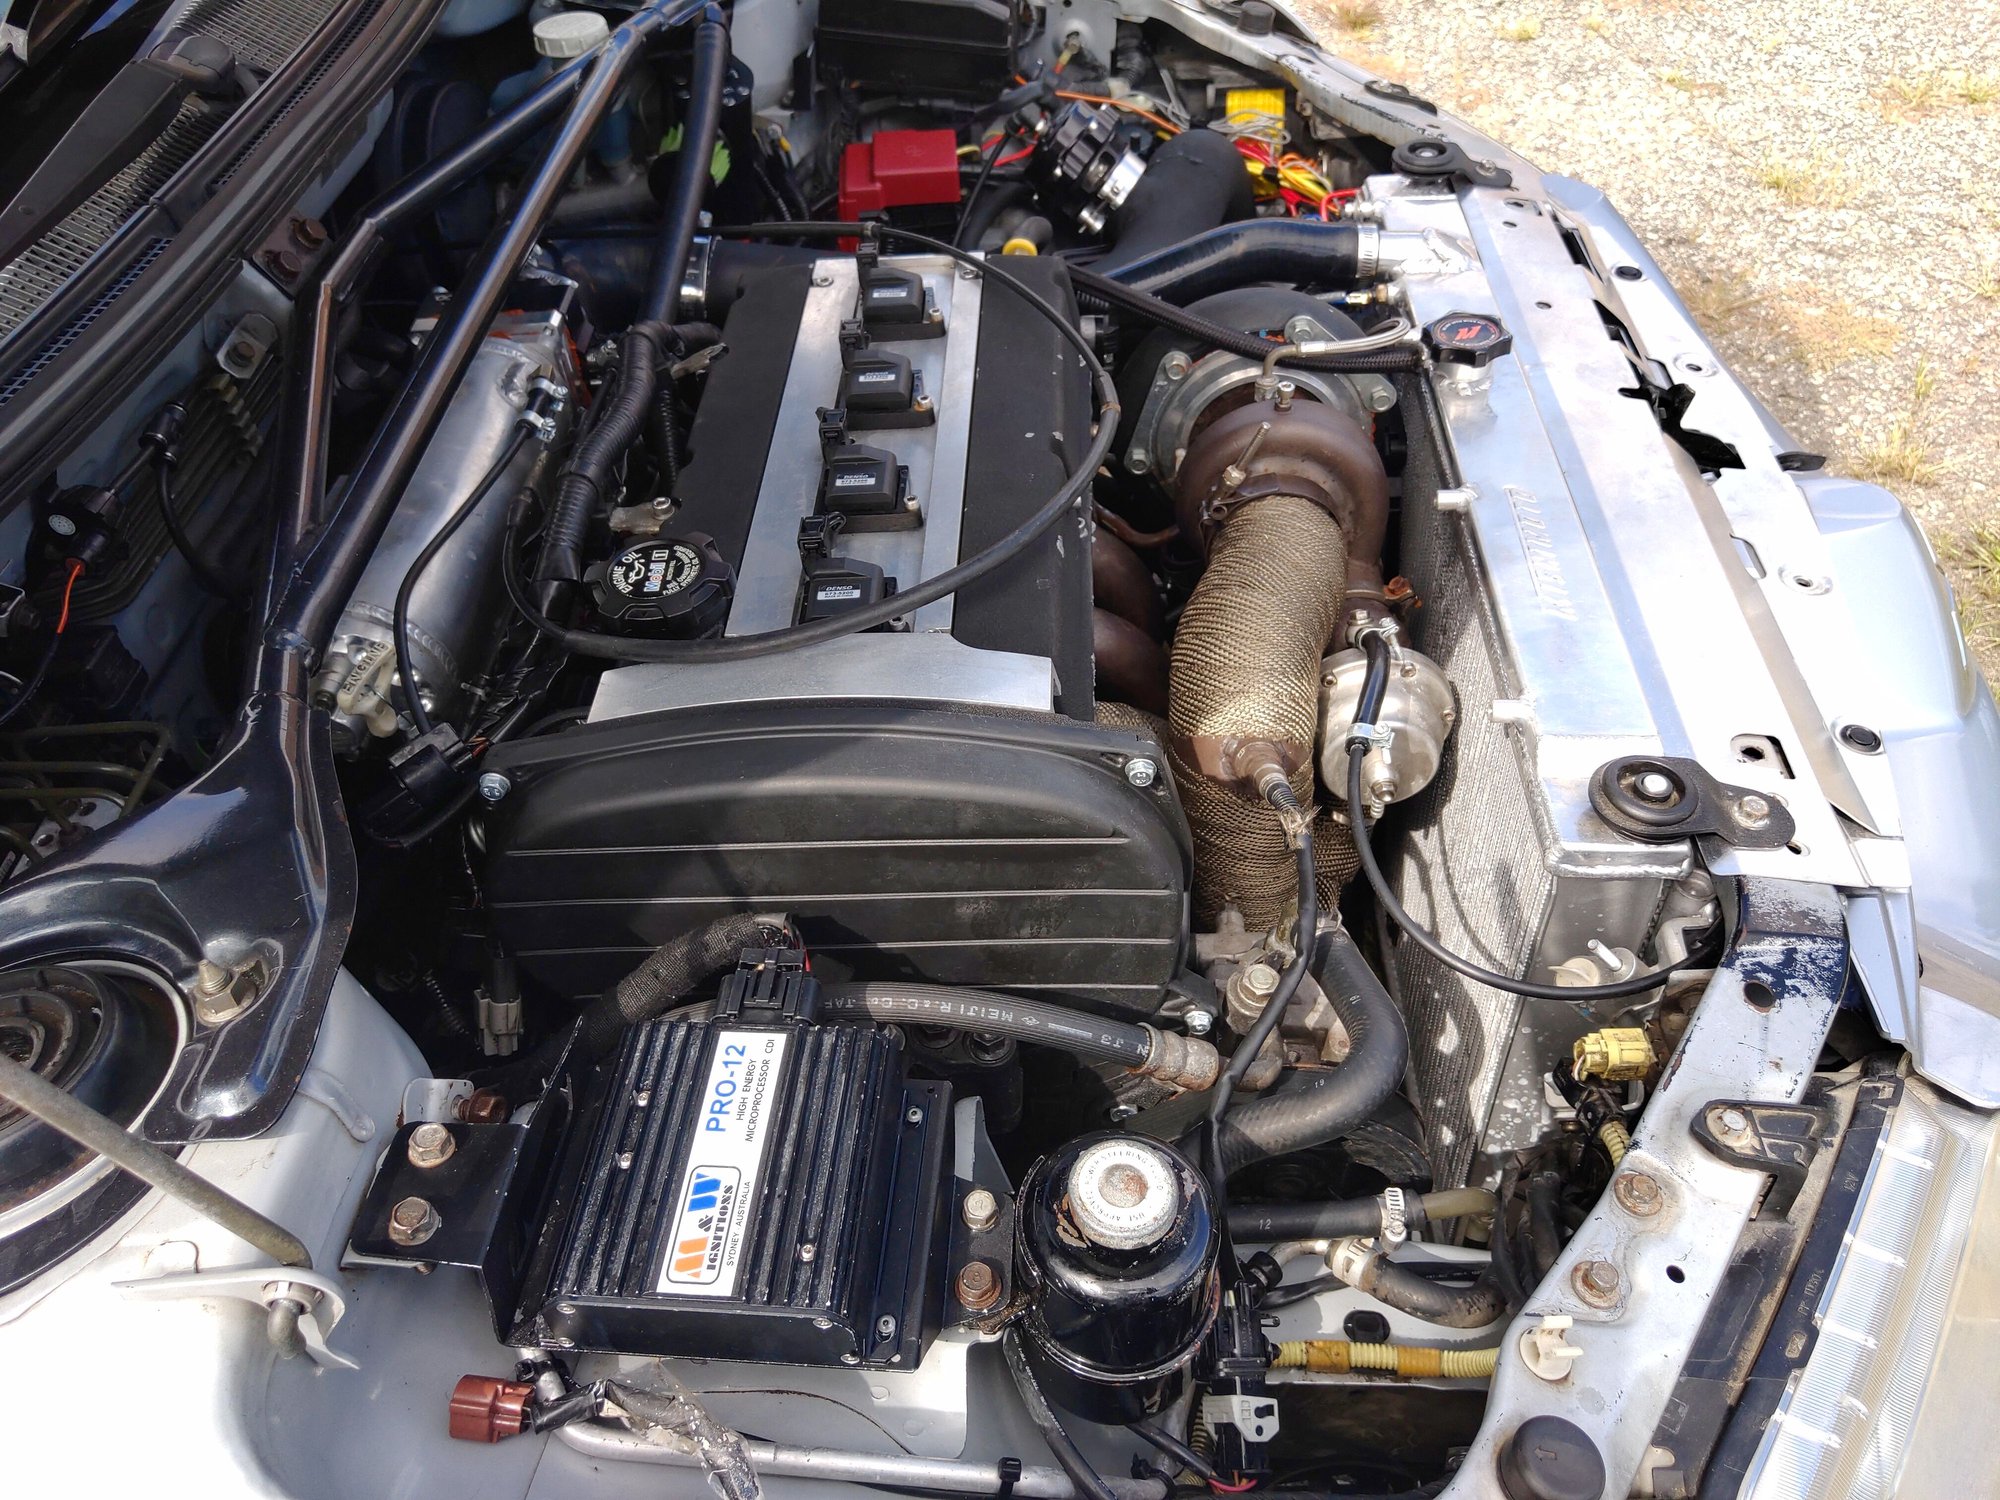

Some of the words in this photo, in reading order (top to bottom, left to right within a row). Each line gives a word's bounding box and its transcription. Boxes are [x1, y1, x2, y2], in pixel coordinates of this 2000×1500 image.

[613, 565, 634, 594] ENGINE
[622, 551, 642, 564] OIL
[643, 562, 667, 592] Mobil
[340, 641, 389, 696] ENGINE
[960, 1003, 1014, 1022] MEIJI
[705, 1044, 747, 1132] PRO-12
[736, 1096, 748, 1120] HIGH
[742, 1059, 757, 1092] ENERGY
[744, 1059, 771, 1142] MICROPROCESSOR
[764, 1039, 775, 1054] CDI
[706, 1185, 734, 1271] IGNITIONS
[726, 1232, 740, 1267] SYDNEY
[735, 1181, 751, 1227] AUSTRALIA
[1258, 1218, 1272, 1231] 12
